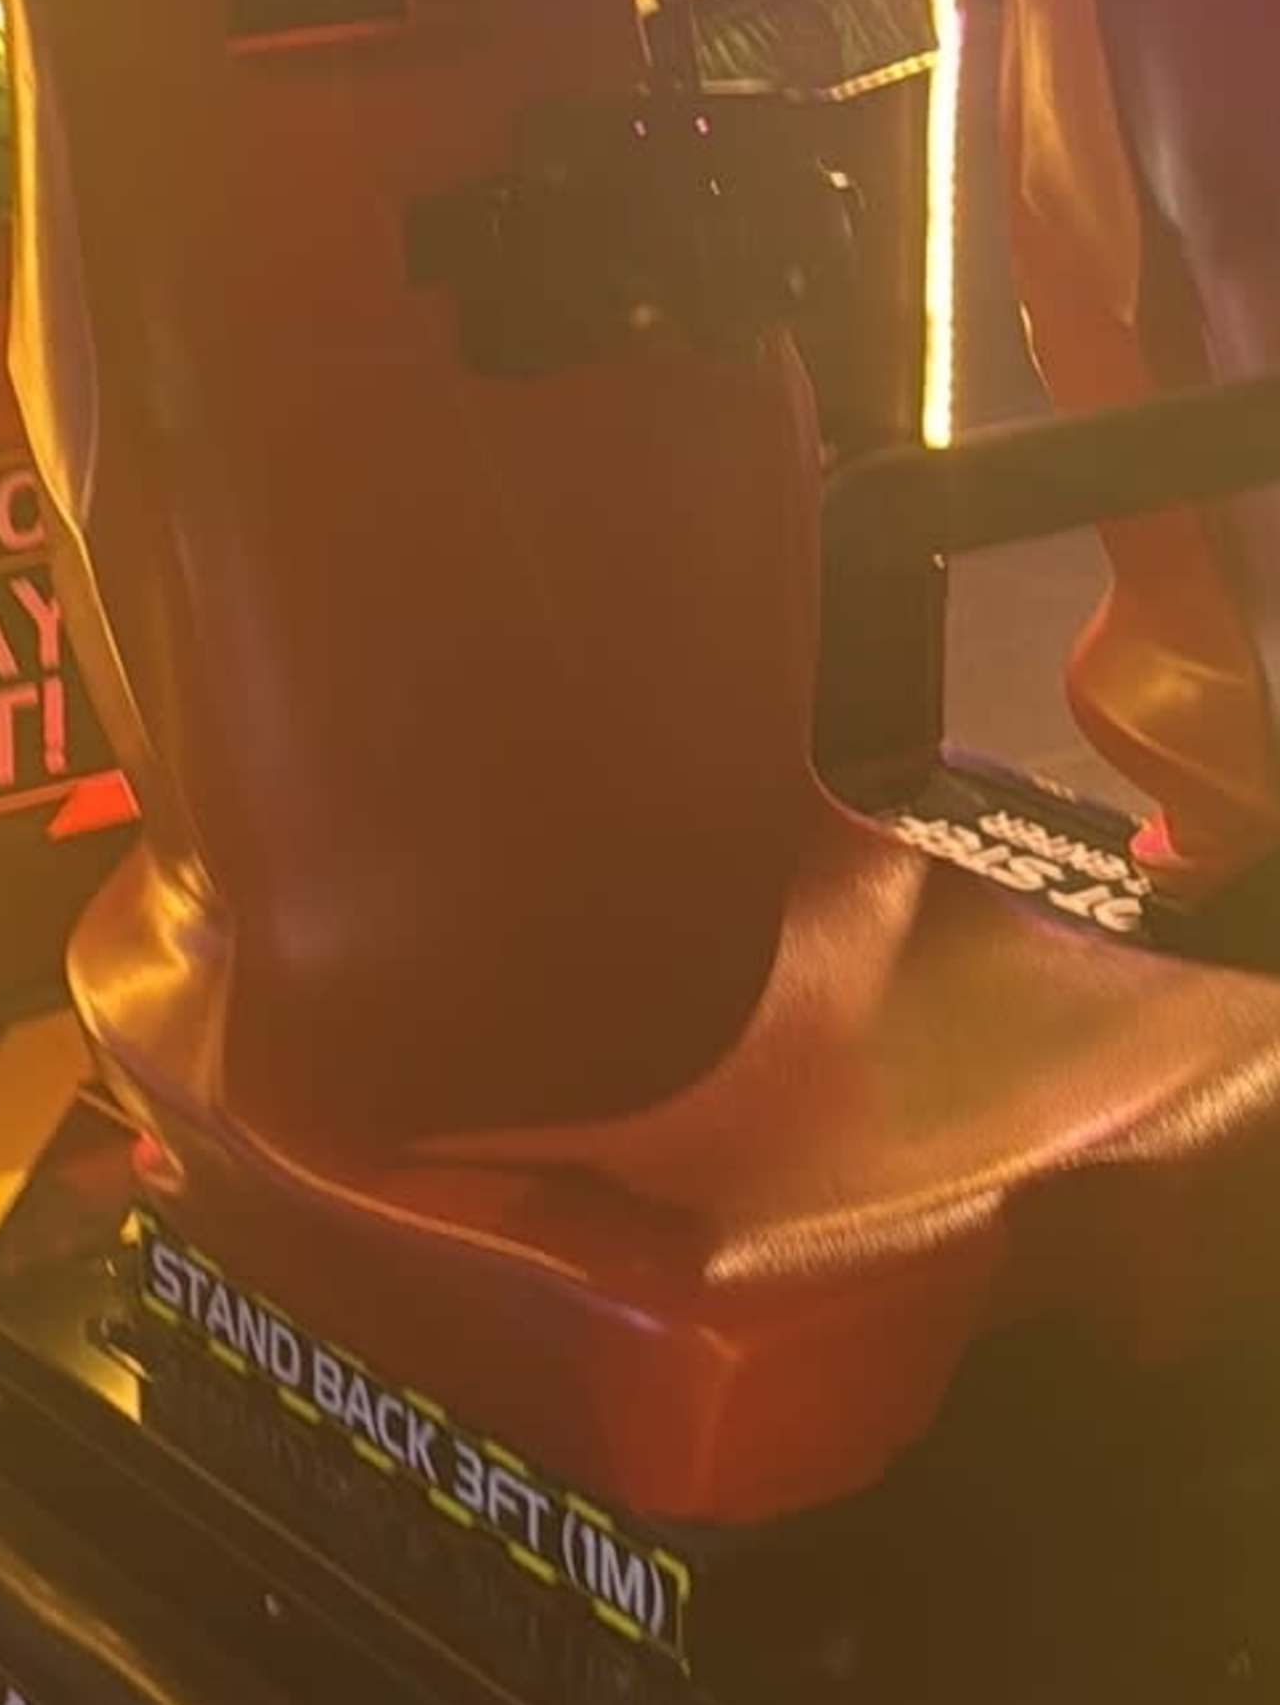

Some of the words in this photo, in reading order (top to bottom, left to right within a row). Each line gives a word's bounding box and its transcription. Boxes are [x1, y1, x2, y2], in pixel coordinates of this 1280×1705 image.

[151, 1242, 301, 1386] STAND
[313, 1347, 438, 1484] BACK
[453, 1440, 553, 1552] 3FT
[562, 1510, 664, 1637] (1M)
